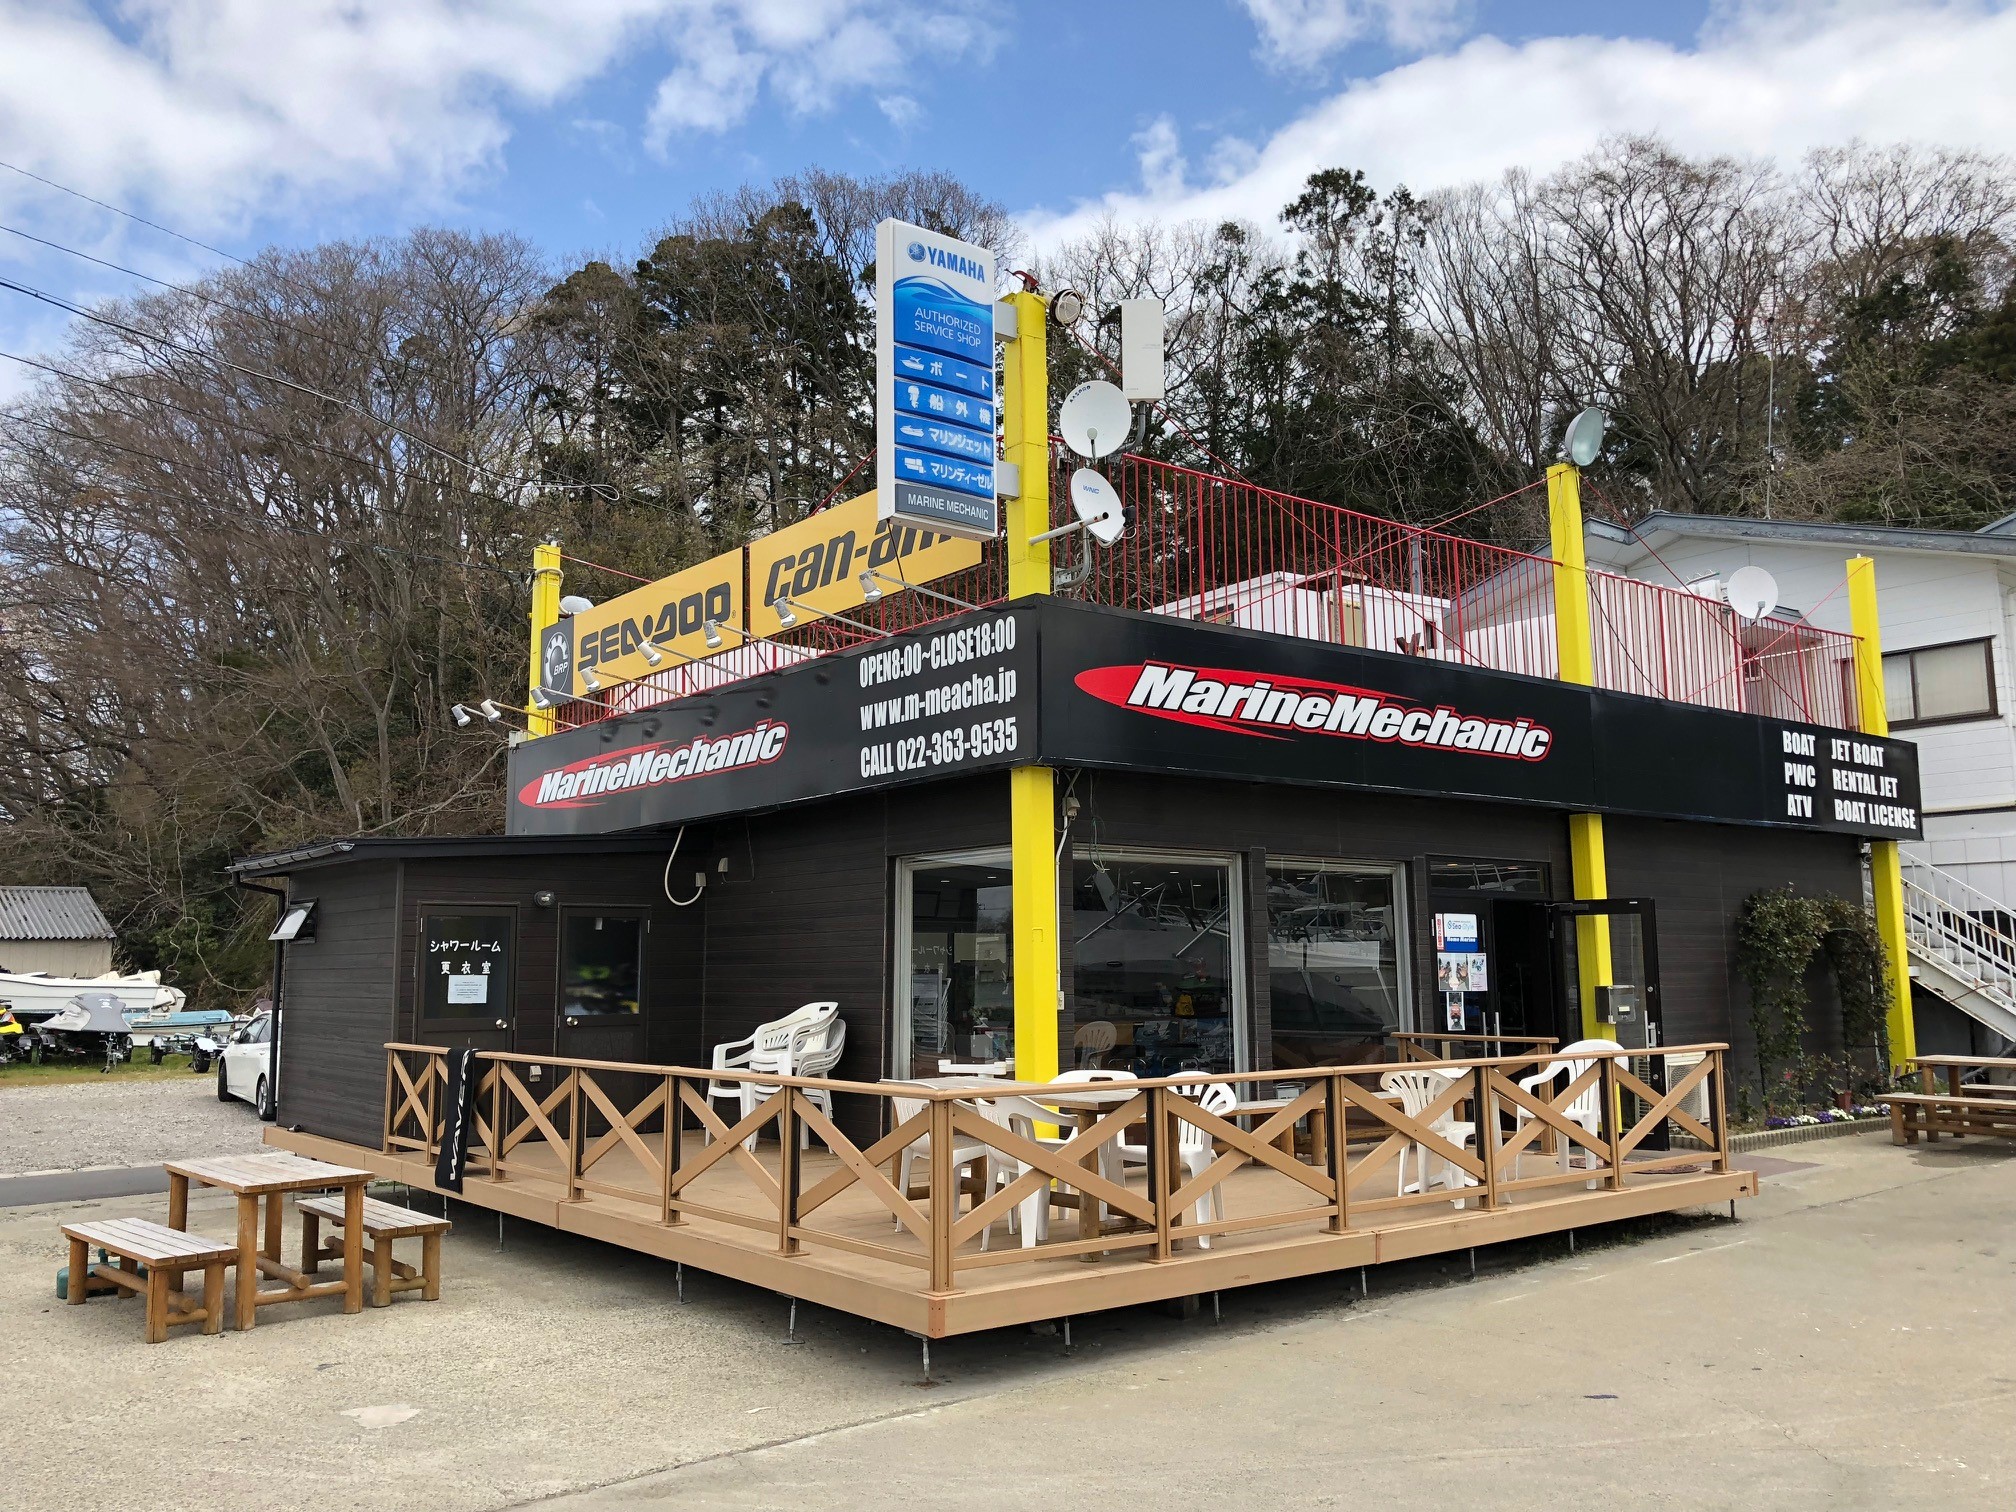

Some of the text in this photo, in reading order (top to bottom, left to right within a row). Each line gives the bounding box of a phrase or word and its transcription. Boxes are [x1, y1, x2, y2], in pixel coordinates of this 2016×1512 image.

[927, 246, 986, 283] YAMAHA
[914, 307, 981, 335] AUTHORIZED
[914, 320, 981, 348] SERVICE SHOP
[930, 361, 989, 391] ボート
[929, 393, 991, 426] 船外機
[928, 427, 991, 459] マリンジェット
[930, 462, 992, 490] マリンディーゼル
[1082, 484, 1100, 495] WNC
[907, 493, 989, 521] MARINE MECHANIC
[553, 661, 568, 676] BRP
[859, 666, 1017, 731] www.m-meacha.jp
[1124, 663, 1551, 759] MarineMechanic
[860, 716, 1018, 778] CALL 022-363-9535
[1782, 730, 1815, 757] BOAT
[1831, 738, 1884, 768] JET BOAT
[535, 722, 788, 805] MarineMechanic
[1784, 762, 1816, 788] PWC
[1832, 768, 1898, 799] RENTAL JET
[1787, 793, 1812, 818] ATV
[1834, 798, 1917, 830] BOAT LICENSE
[429, 939, 501, 953] シャワールーム
[441, 960, 491, 975] 更衣室
